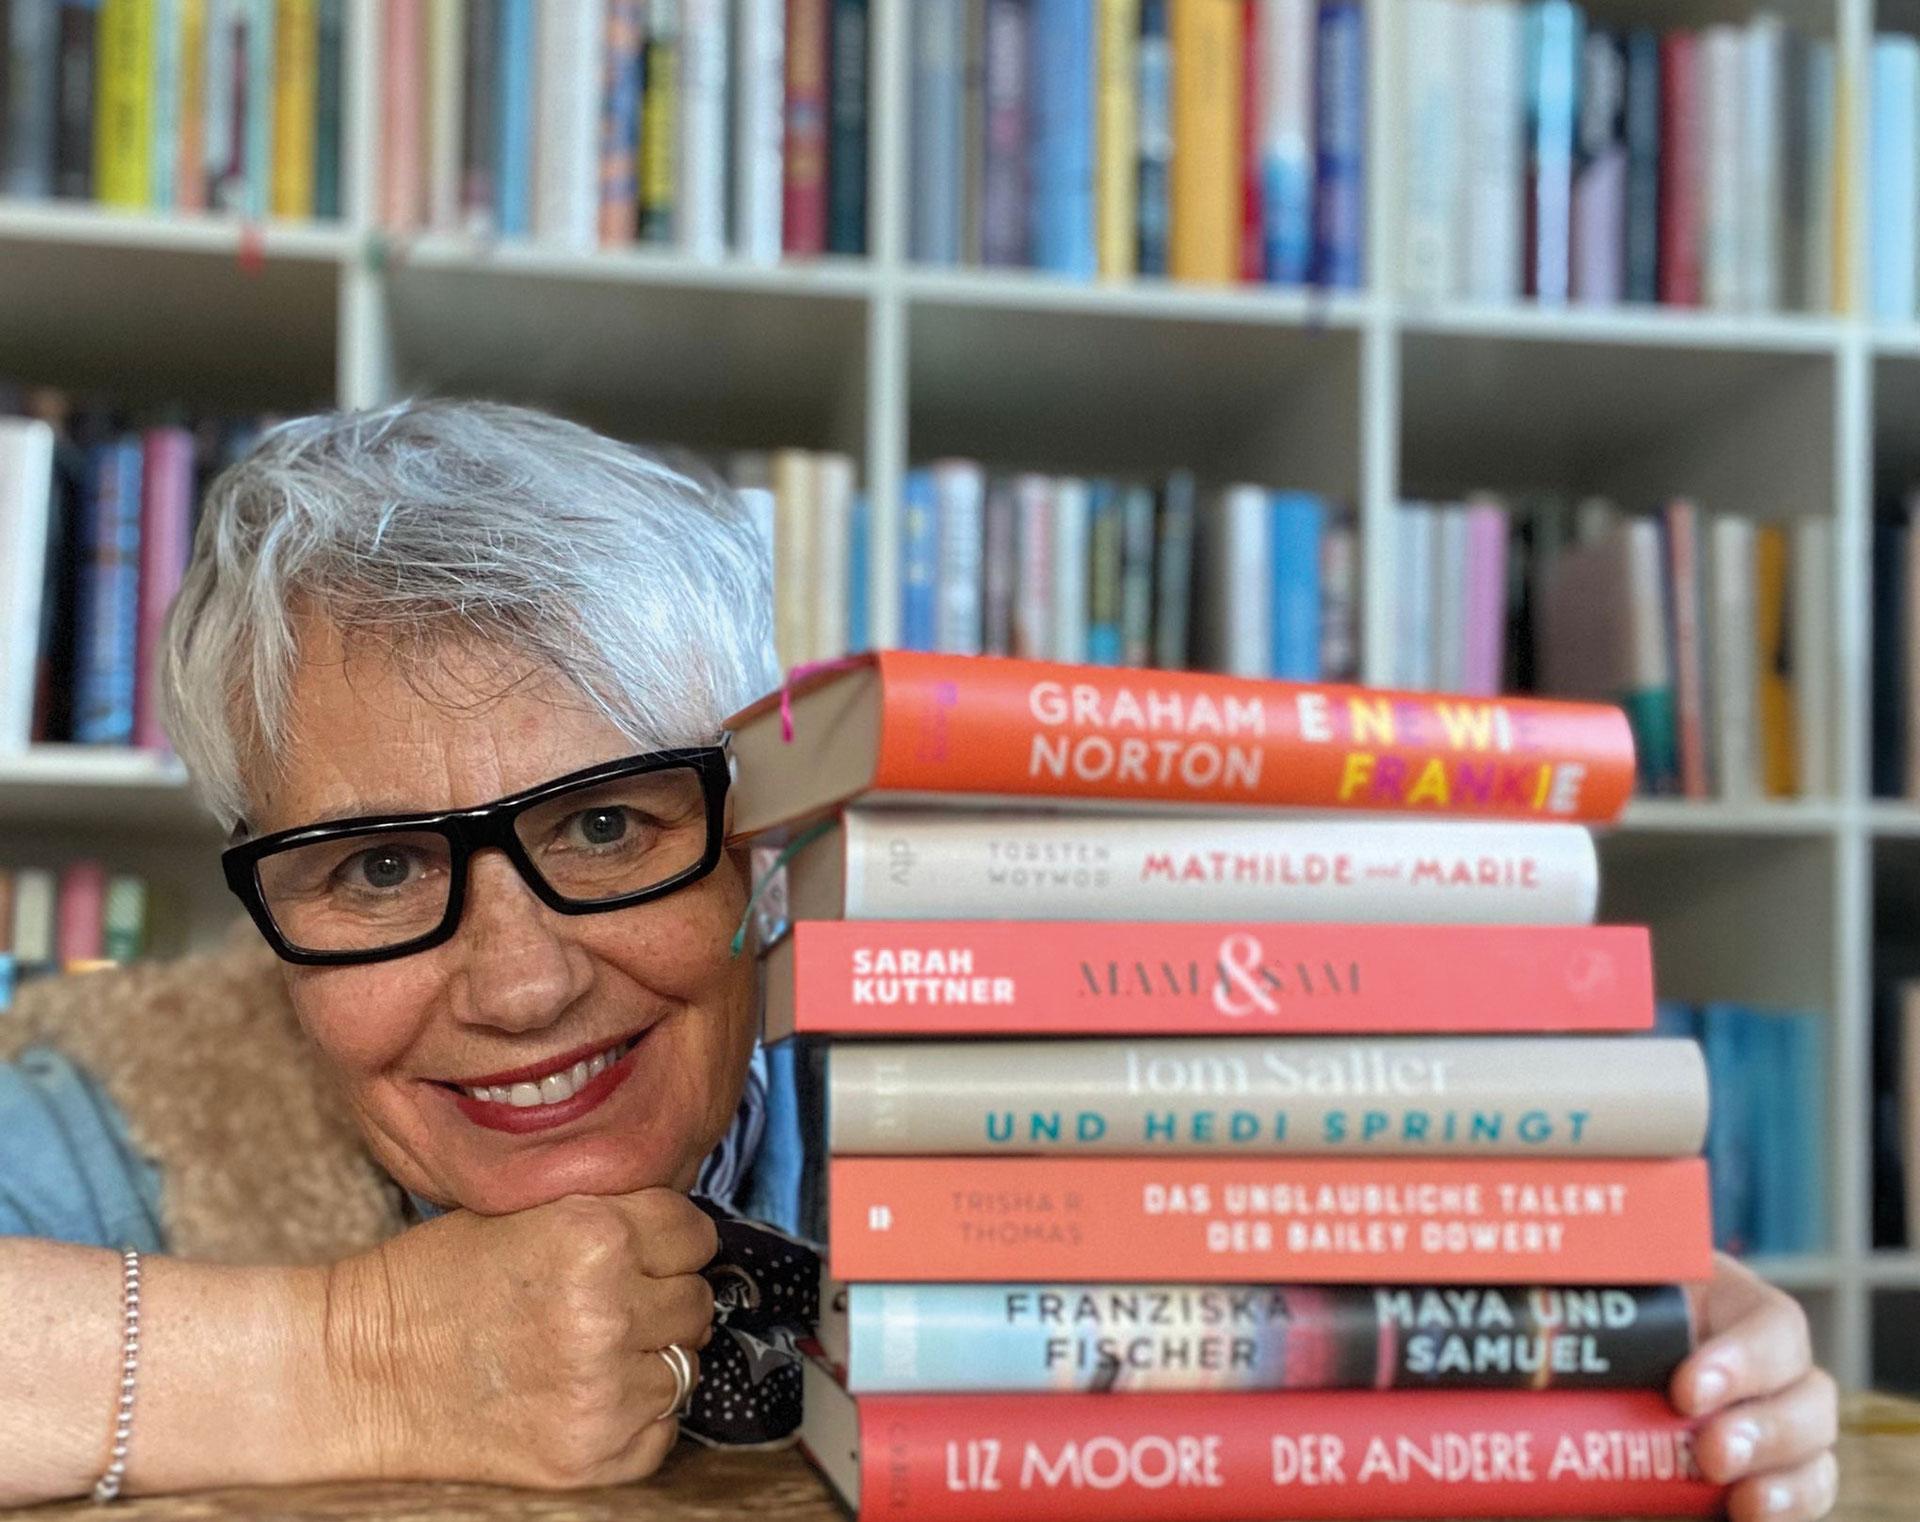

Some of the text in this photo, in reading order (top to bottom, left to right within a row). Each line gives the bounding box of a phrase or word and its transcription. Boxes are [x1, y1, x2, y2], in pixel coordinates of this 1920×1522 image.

[1028, 680, 1267, 738] GRAHAM
[1028, 733, 1264, 790] NORTON
[1339, 752, 1587, 815] FRANKIE
[1139, 850, 1354, 887] MATHILDE
[1409, 856, 1542, 890] MARIE
[852, 948, 974, 976] SARAH
[852, 977, 1016, 1005] KUTTNER
[985, 1110, 1592, 1145] UND HEDI SPRINGT
[1143, 1183, 1628, 1216] DAS UNGLAUBLICHE TALENT
[960, 1220, 1085, 1246] THOMAS
[1206, 1221, 1565, 1254] DER BAILEY DOWERY
[1005, 1290, 1293, 1327] FRANZISKA
[1376, 1289, 1639, 1330] MAYA UND
[1044, 1336, 1258, 1371] FISCHER
[1405, 1333, 1612, 1374] SAMUEL
[945, 1437, 1002, 1492] LIZ
[1019, 1435, 1225, 1491] MOORE
[1270, 1432, 1347, 1486] DER
[1357, 1431, 1536, 1485] ANDERE
